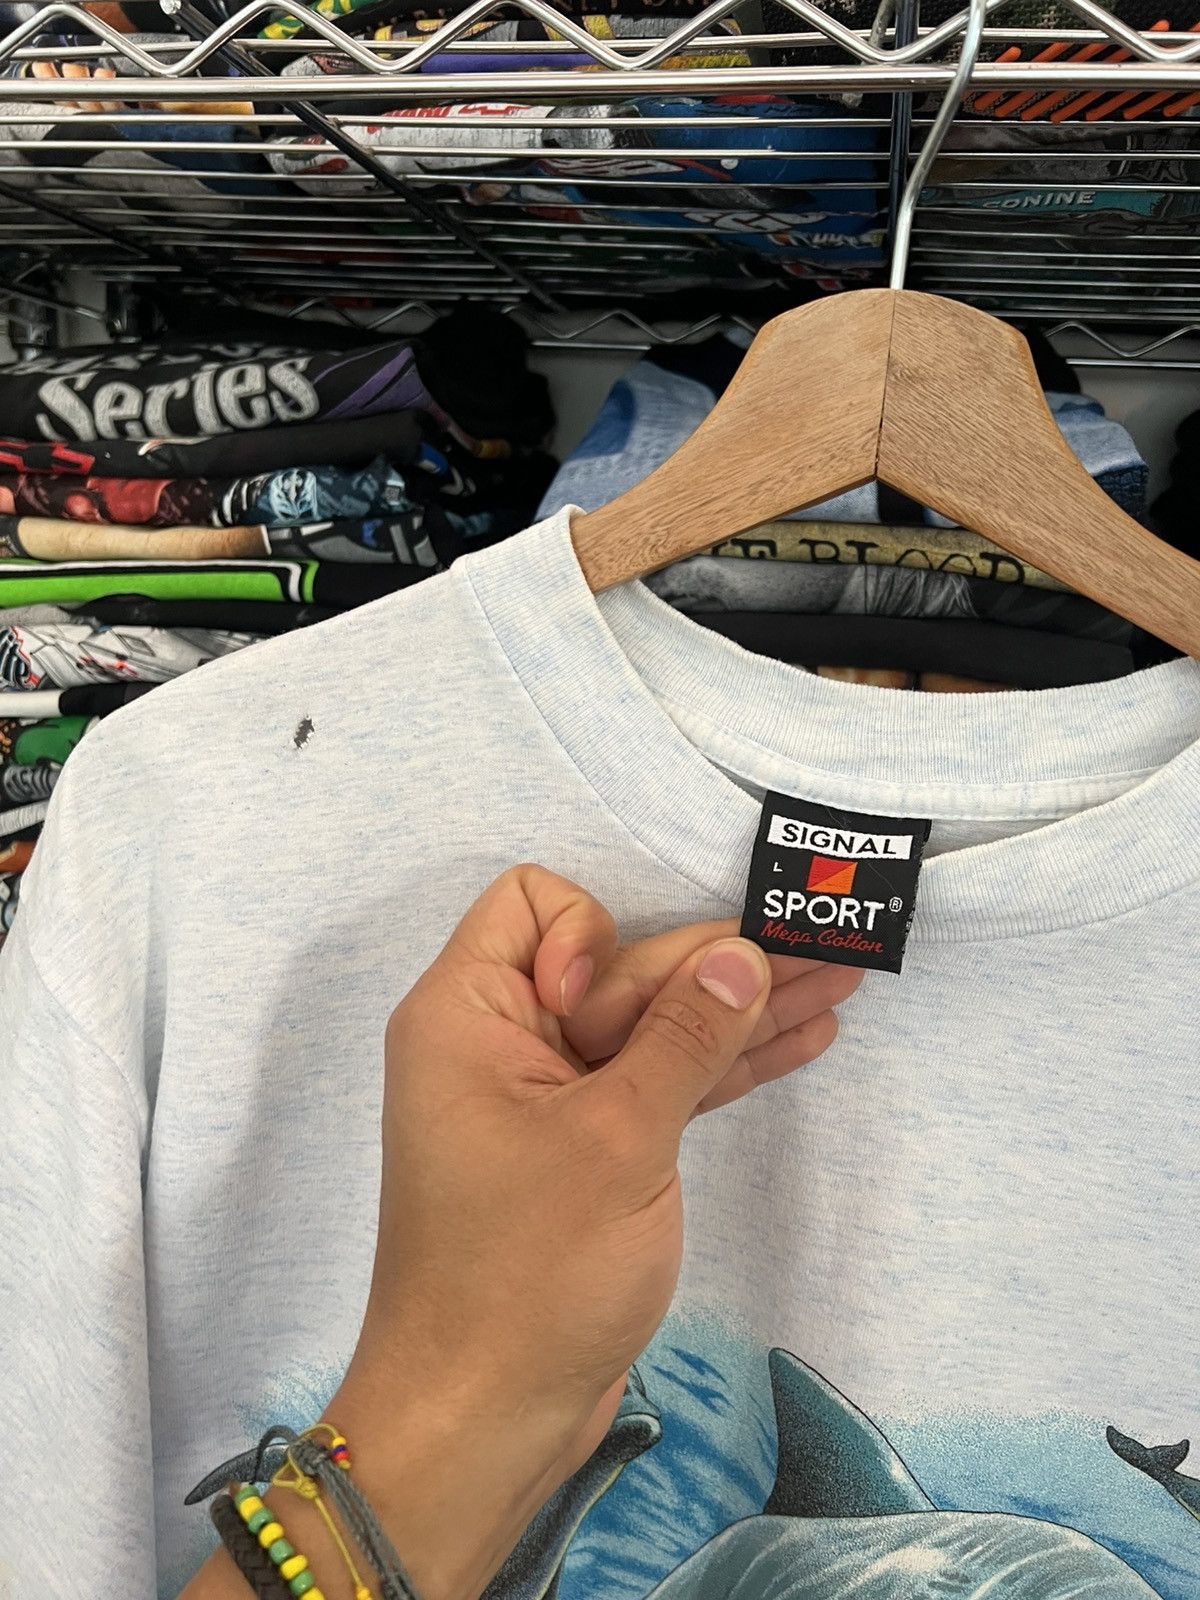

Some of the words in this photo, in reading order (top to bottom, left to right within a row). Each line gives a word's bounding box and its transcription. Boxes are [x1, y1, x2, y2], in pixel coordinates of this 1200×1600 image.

[35, 356, 320, 442] Series
[781, 822, 898, 855] SIGNAL
[772, 861, 784, 872] L
[760, 919, 814, 944] Mega
[816, 928, 884, 953] Cotton
